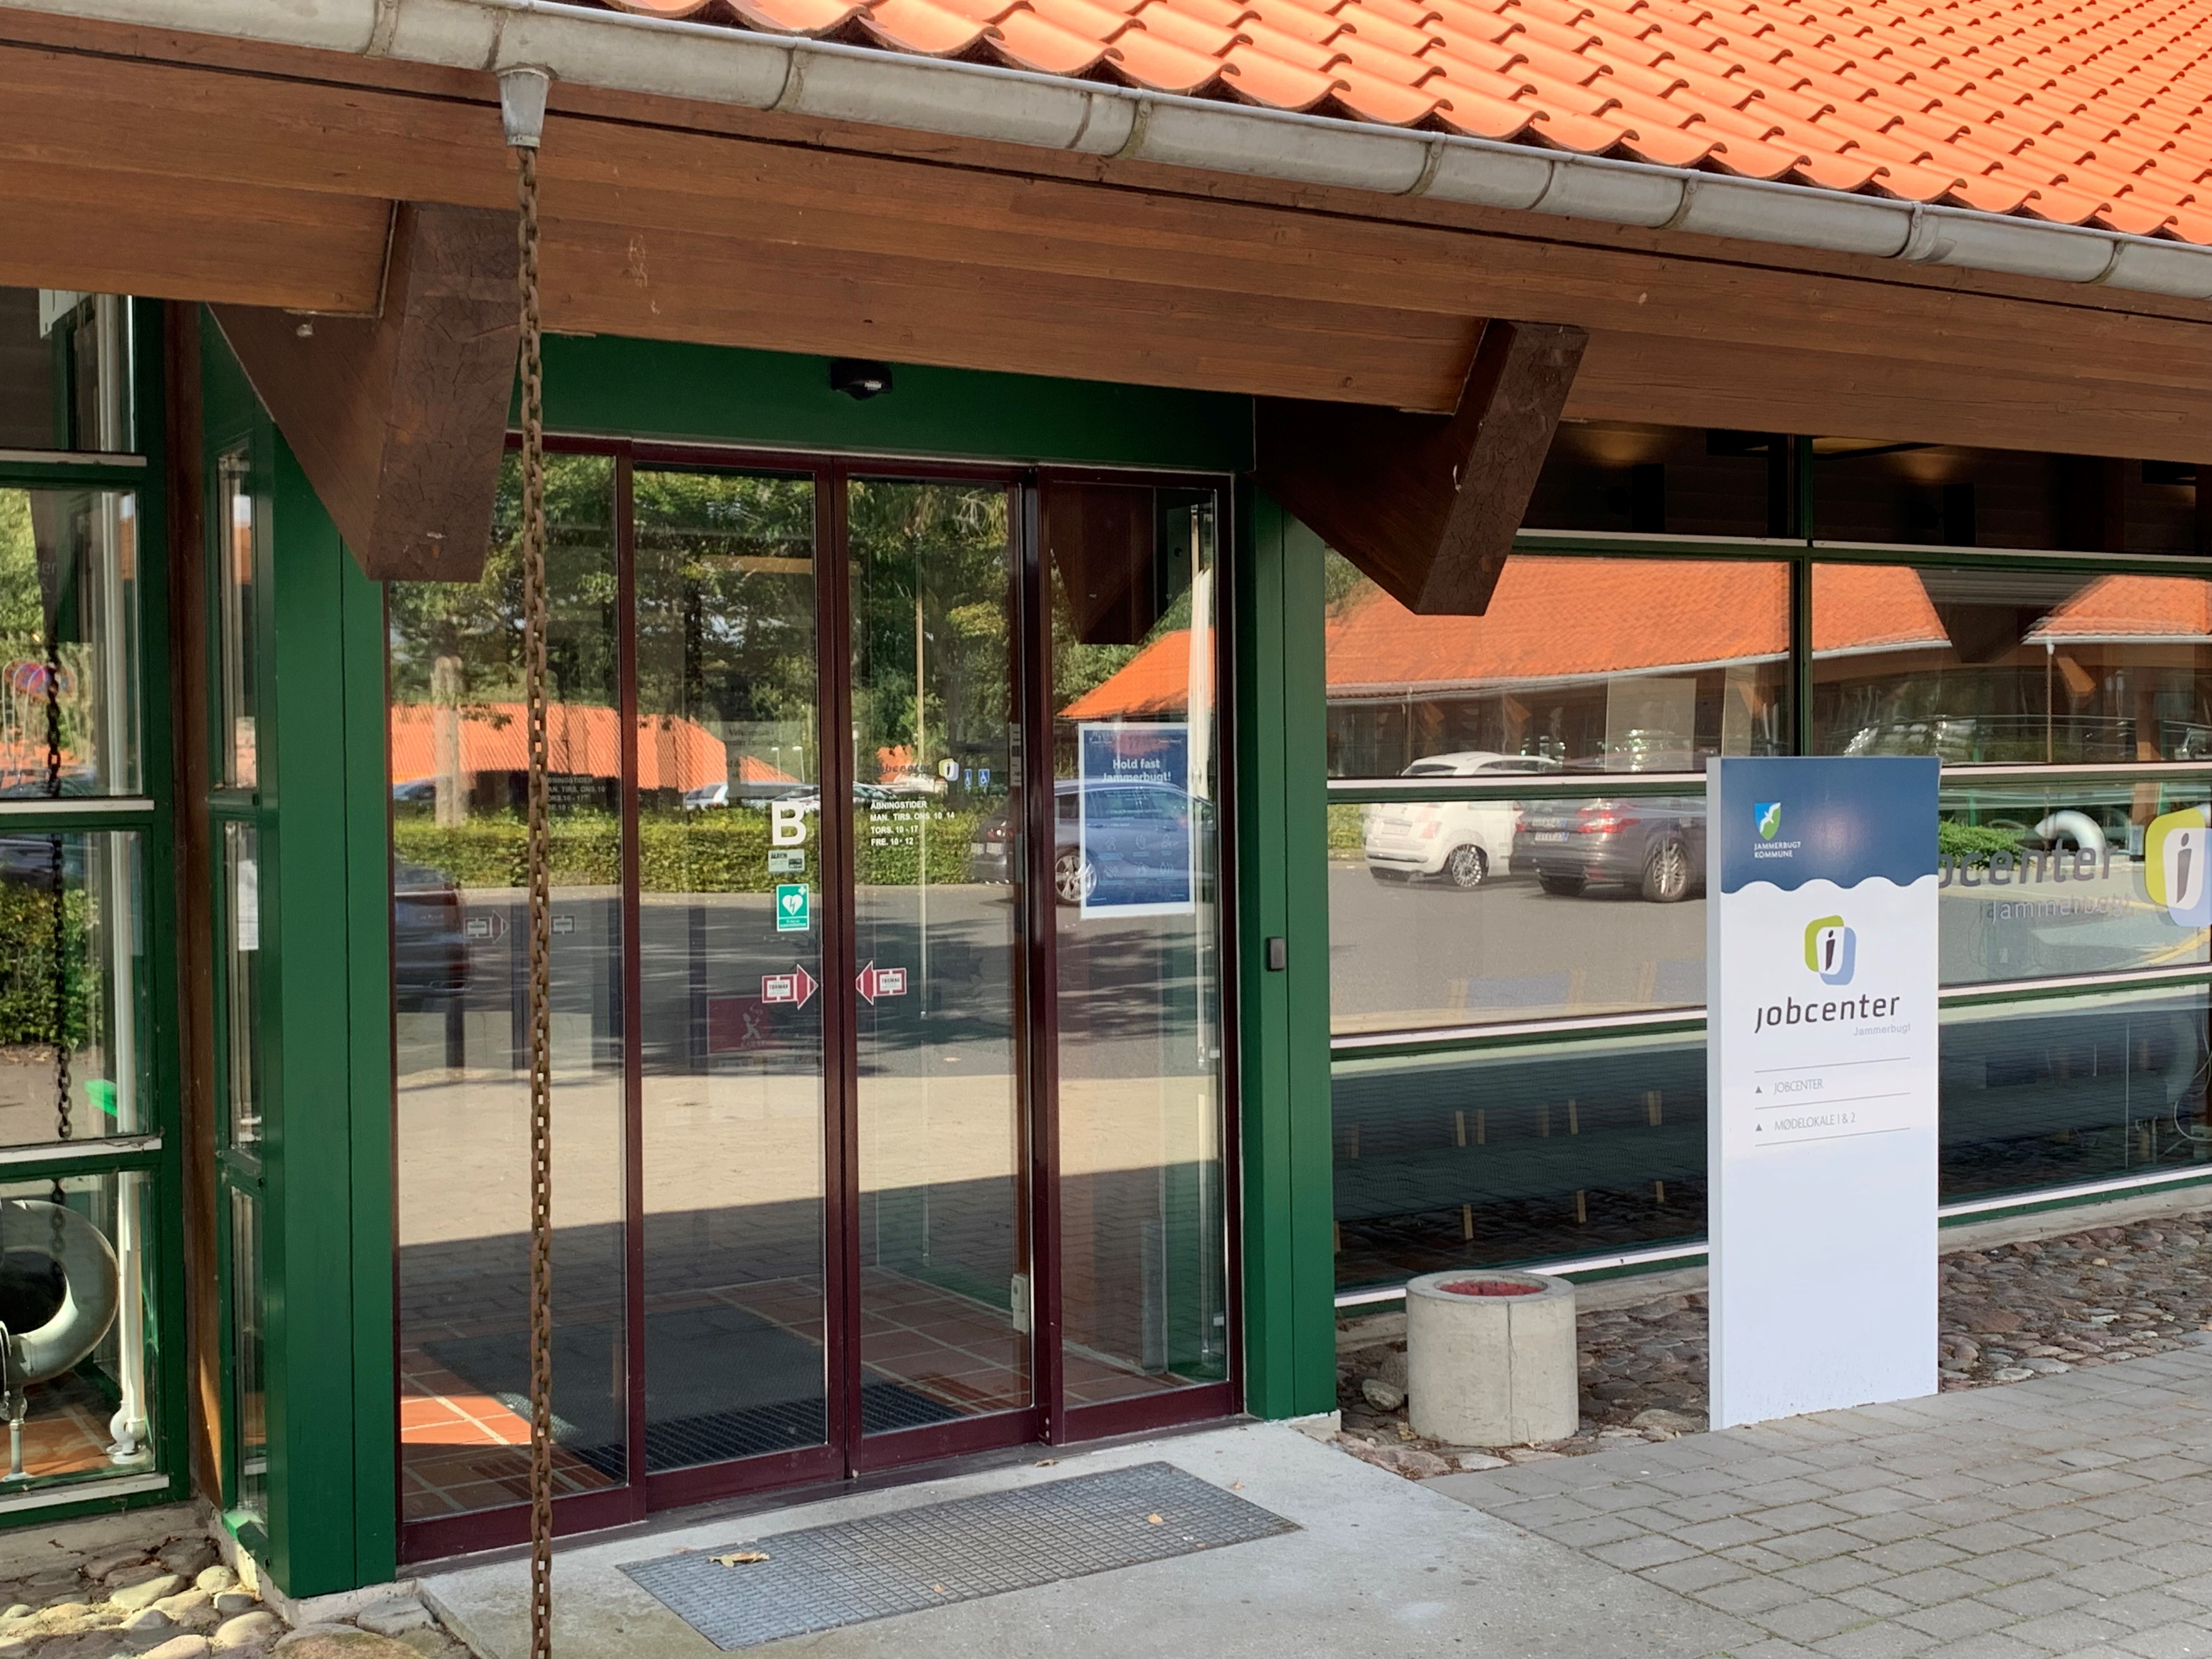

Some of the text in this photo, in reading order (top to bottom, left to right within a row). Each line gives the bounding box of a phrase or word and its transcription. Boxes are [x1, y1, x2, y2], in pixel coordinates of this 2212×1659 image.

[1113, 758, 1160, 769] Hold fast
[1102, 771, 1172, 783] Jammerbugt!
[946, 811, 955, 819] 14
[771, 801, 806, 845] B
[870, 826, 894, 834] TORS.
[871, 838, 889, 846] FRE.
[905, 837, 914, 845] 12
[1754, 841, 1802, 851] JAMMERBUGT
[1754, 849, 1793, 859] KOMMUNE
[1754, 994, 1900, 1034] jobcenter
[1853, 1023, 1912, 1036] Jammerbugt
[1773, 1078, 1824, 1095] JOBCENTER
[1774, 1114, 1835, 1131] MØDELOKALE
[1842, 1113, 1849, 1124] &
[1850, 1111, 1856, 1123] 2
